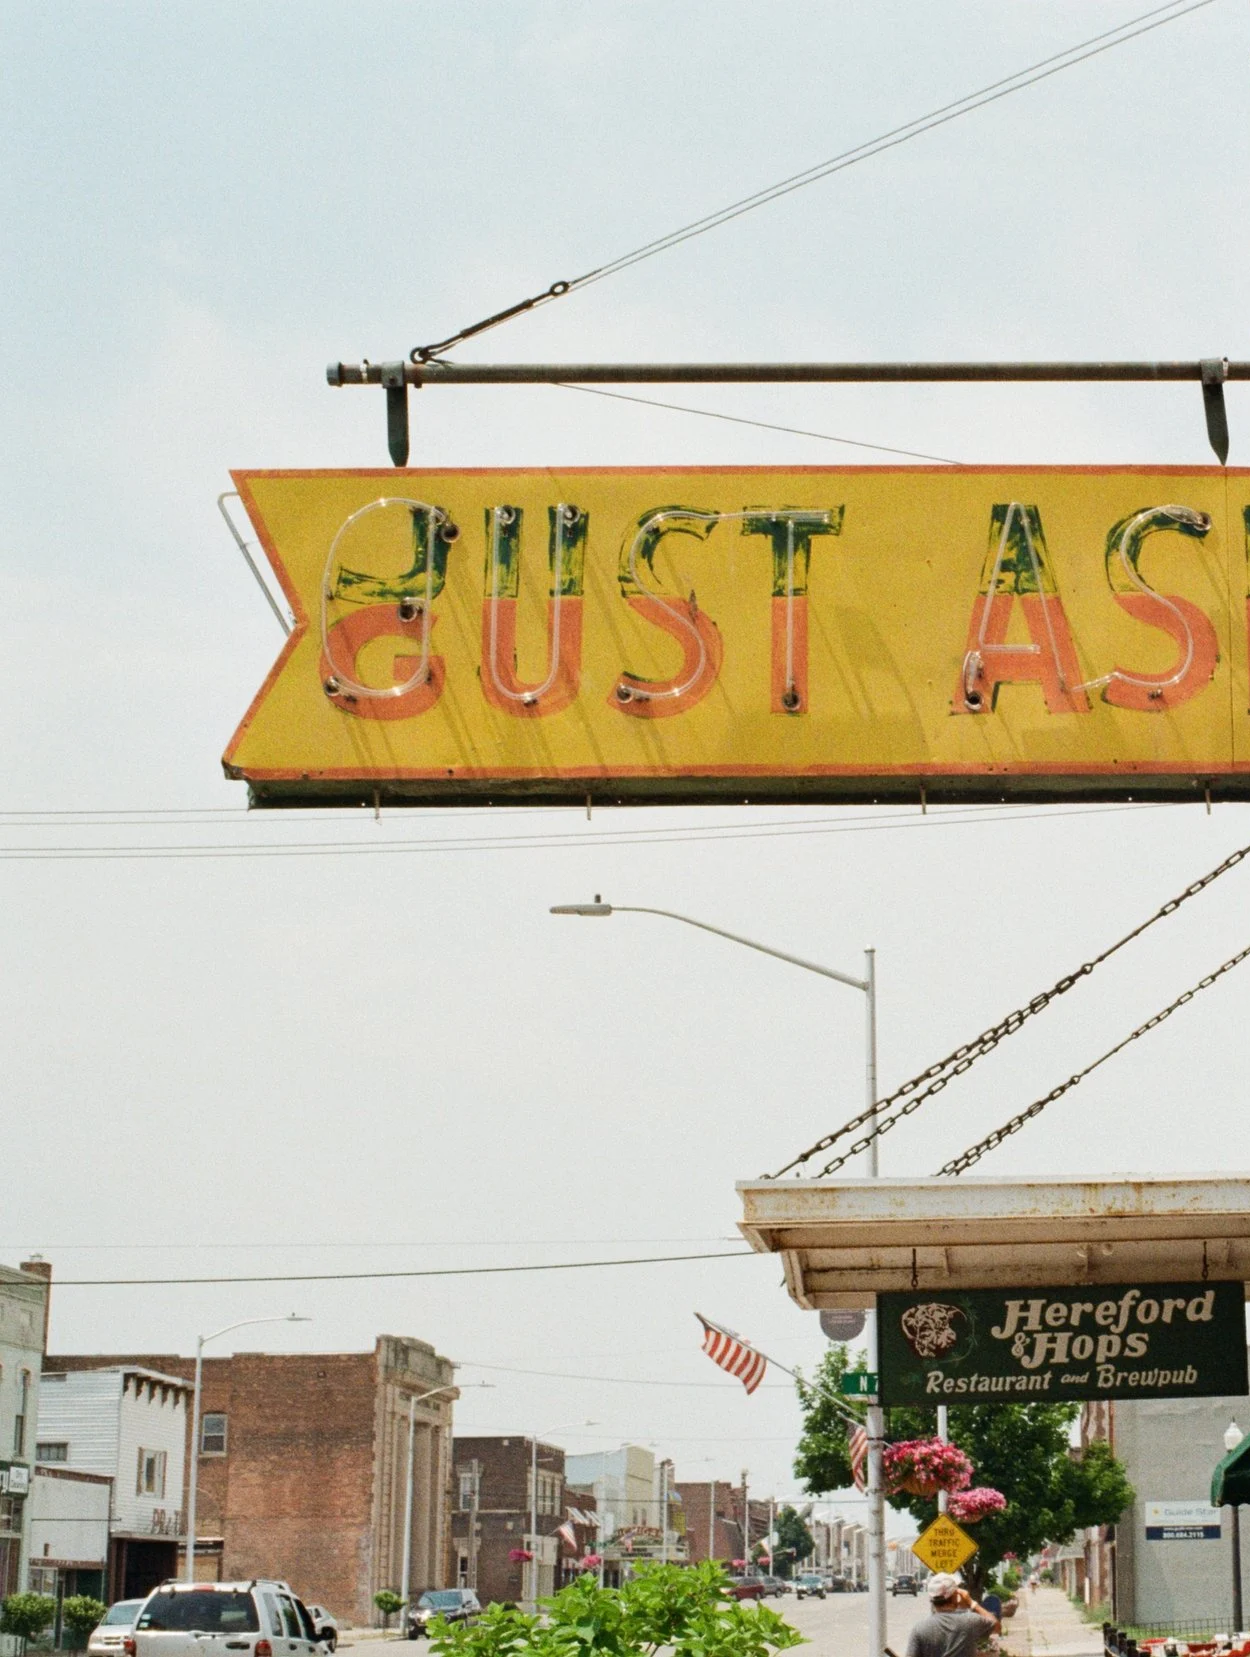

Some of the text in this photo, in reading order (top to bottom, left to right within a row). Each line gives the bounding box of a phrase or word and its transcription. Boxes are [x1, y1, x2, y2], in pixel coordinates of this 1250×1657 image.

[991, 1289, 1216, 1340] Hereford
[859, 1375, 868, 1392] N
[926, 1364, 1198, 1394] Restaurant and Brewpub
[929, 1538, 960, 1547] TRAFFIC
[930, 1549, 957, 1558] MERGE
